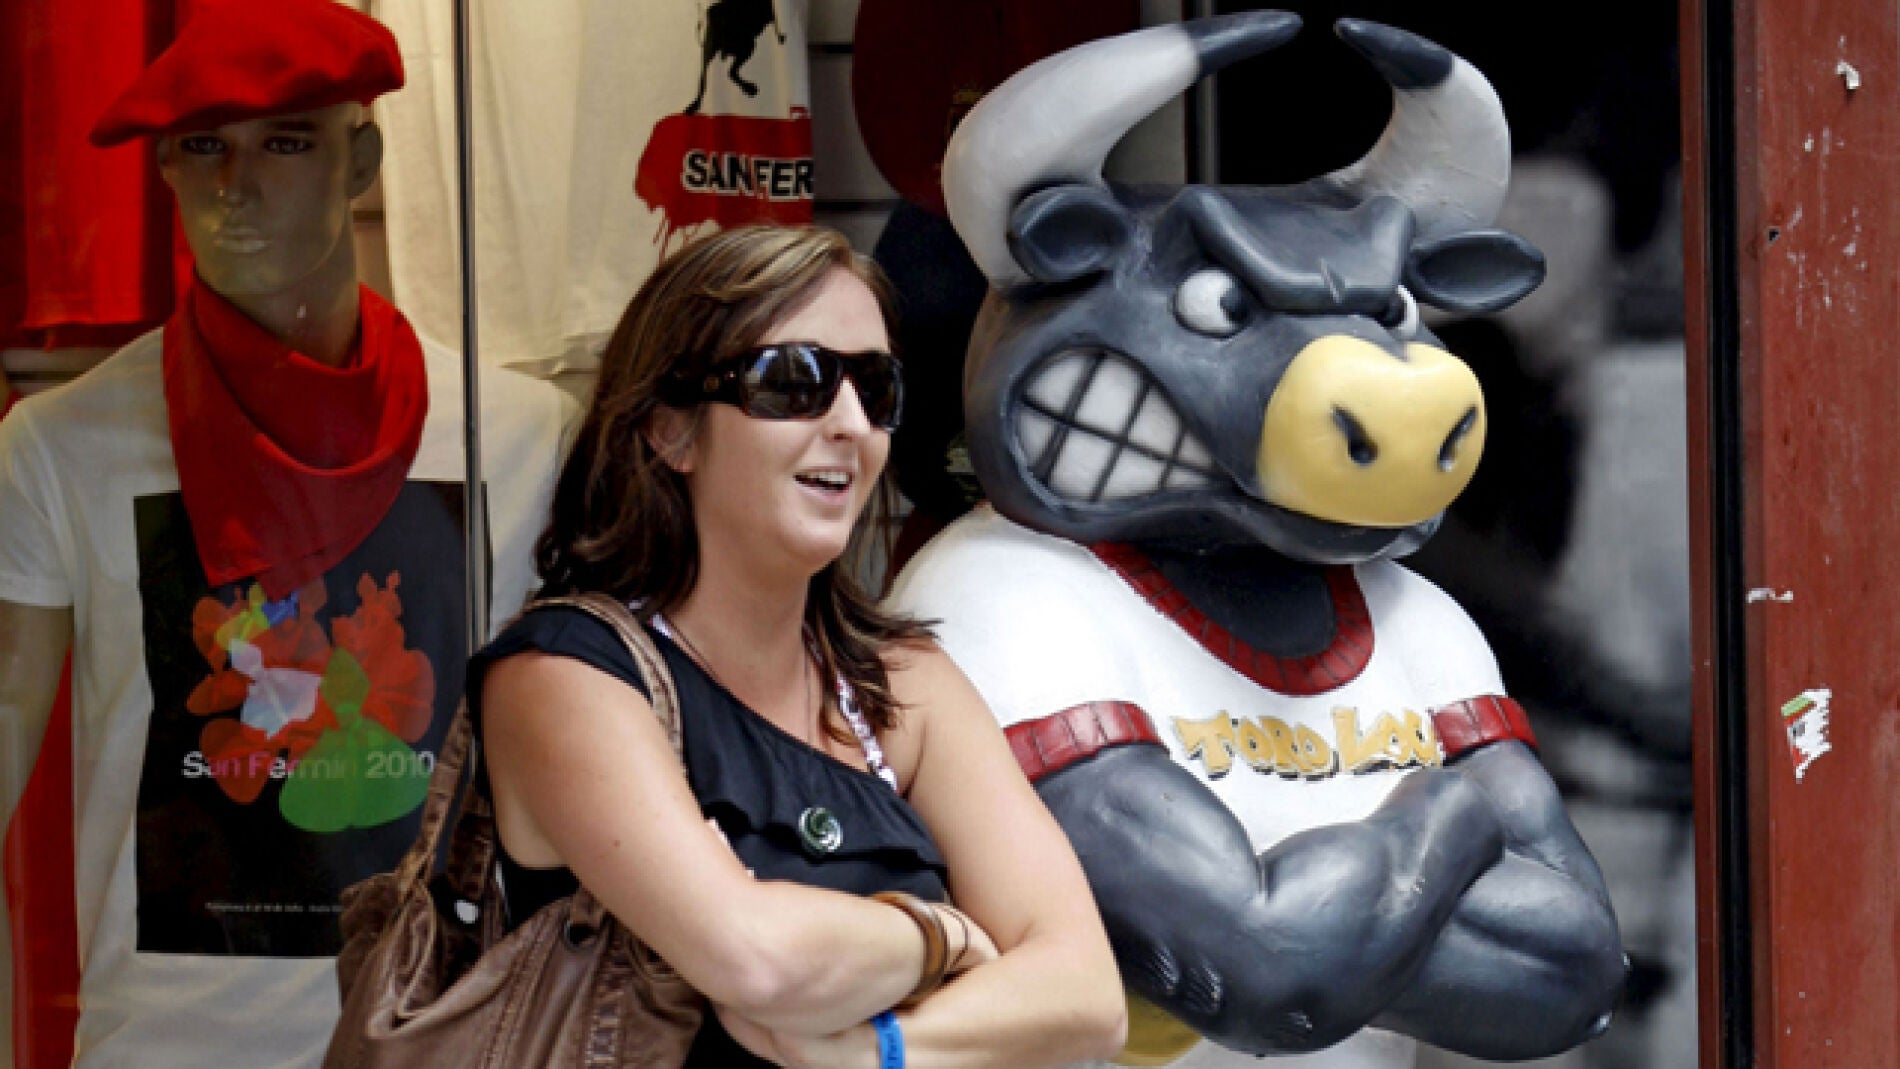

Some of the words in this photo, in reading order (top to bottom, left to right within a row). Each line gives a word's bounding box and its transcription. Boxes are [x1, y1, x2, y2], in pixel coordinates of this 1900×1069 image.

[682, 150, 753, 196] SAN
[181, 751, 241, 778] San
[367, 751, 434, 778] 2010
